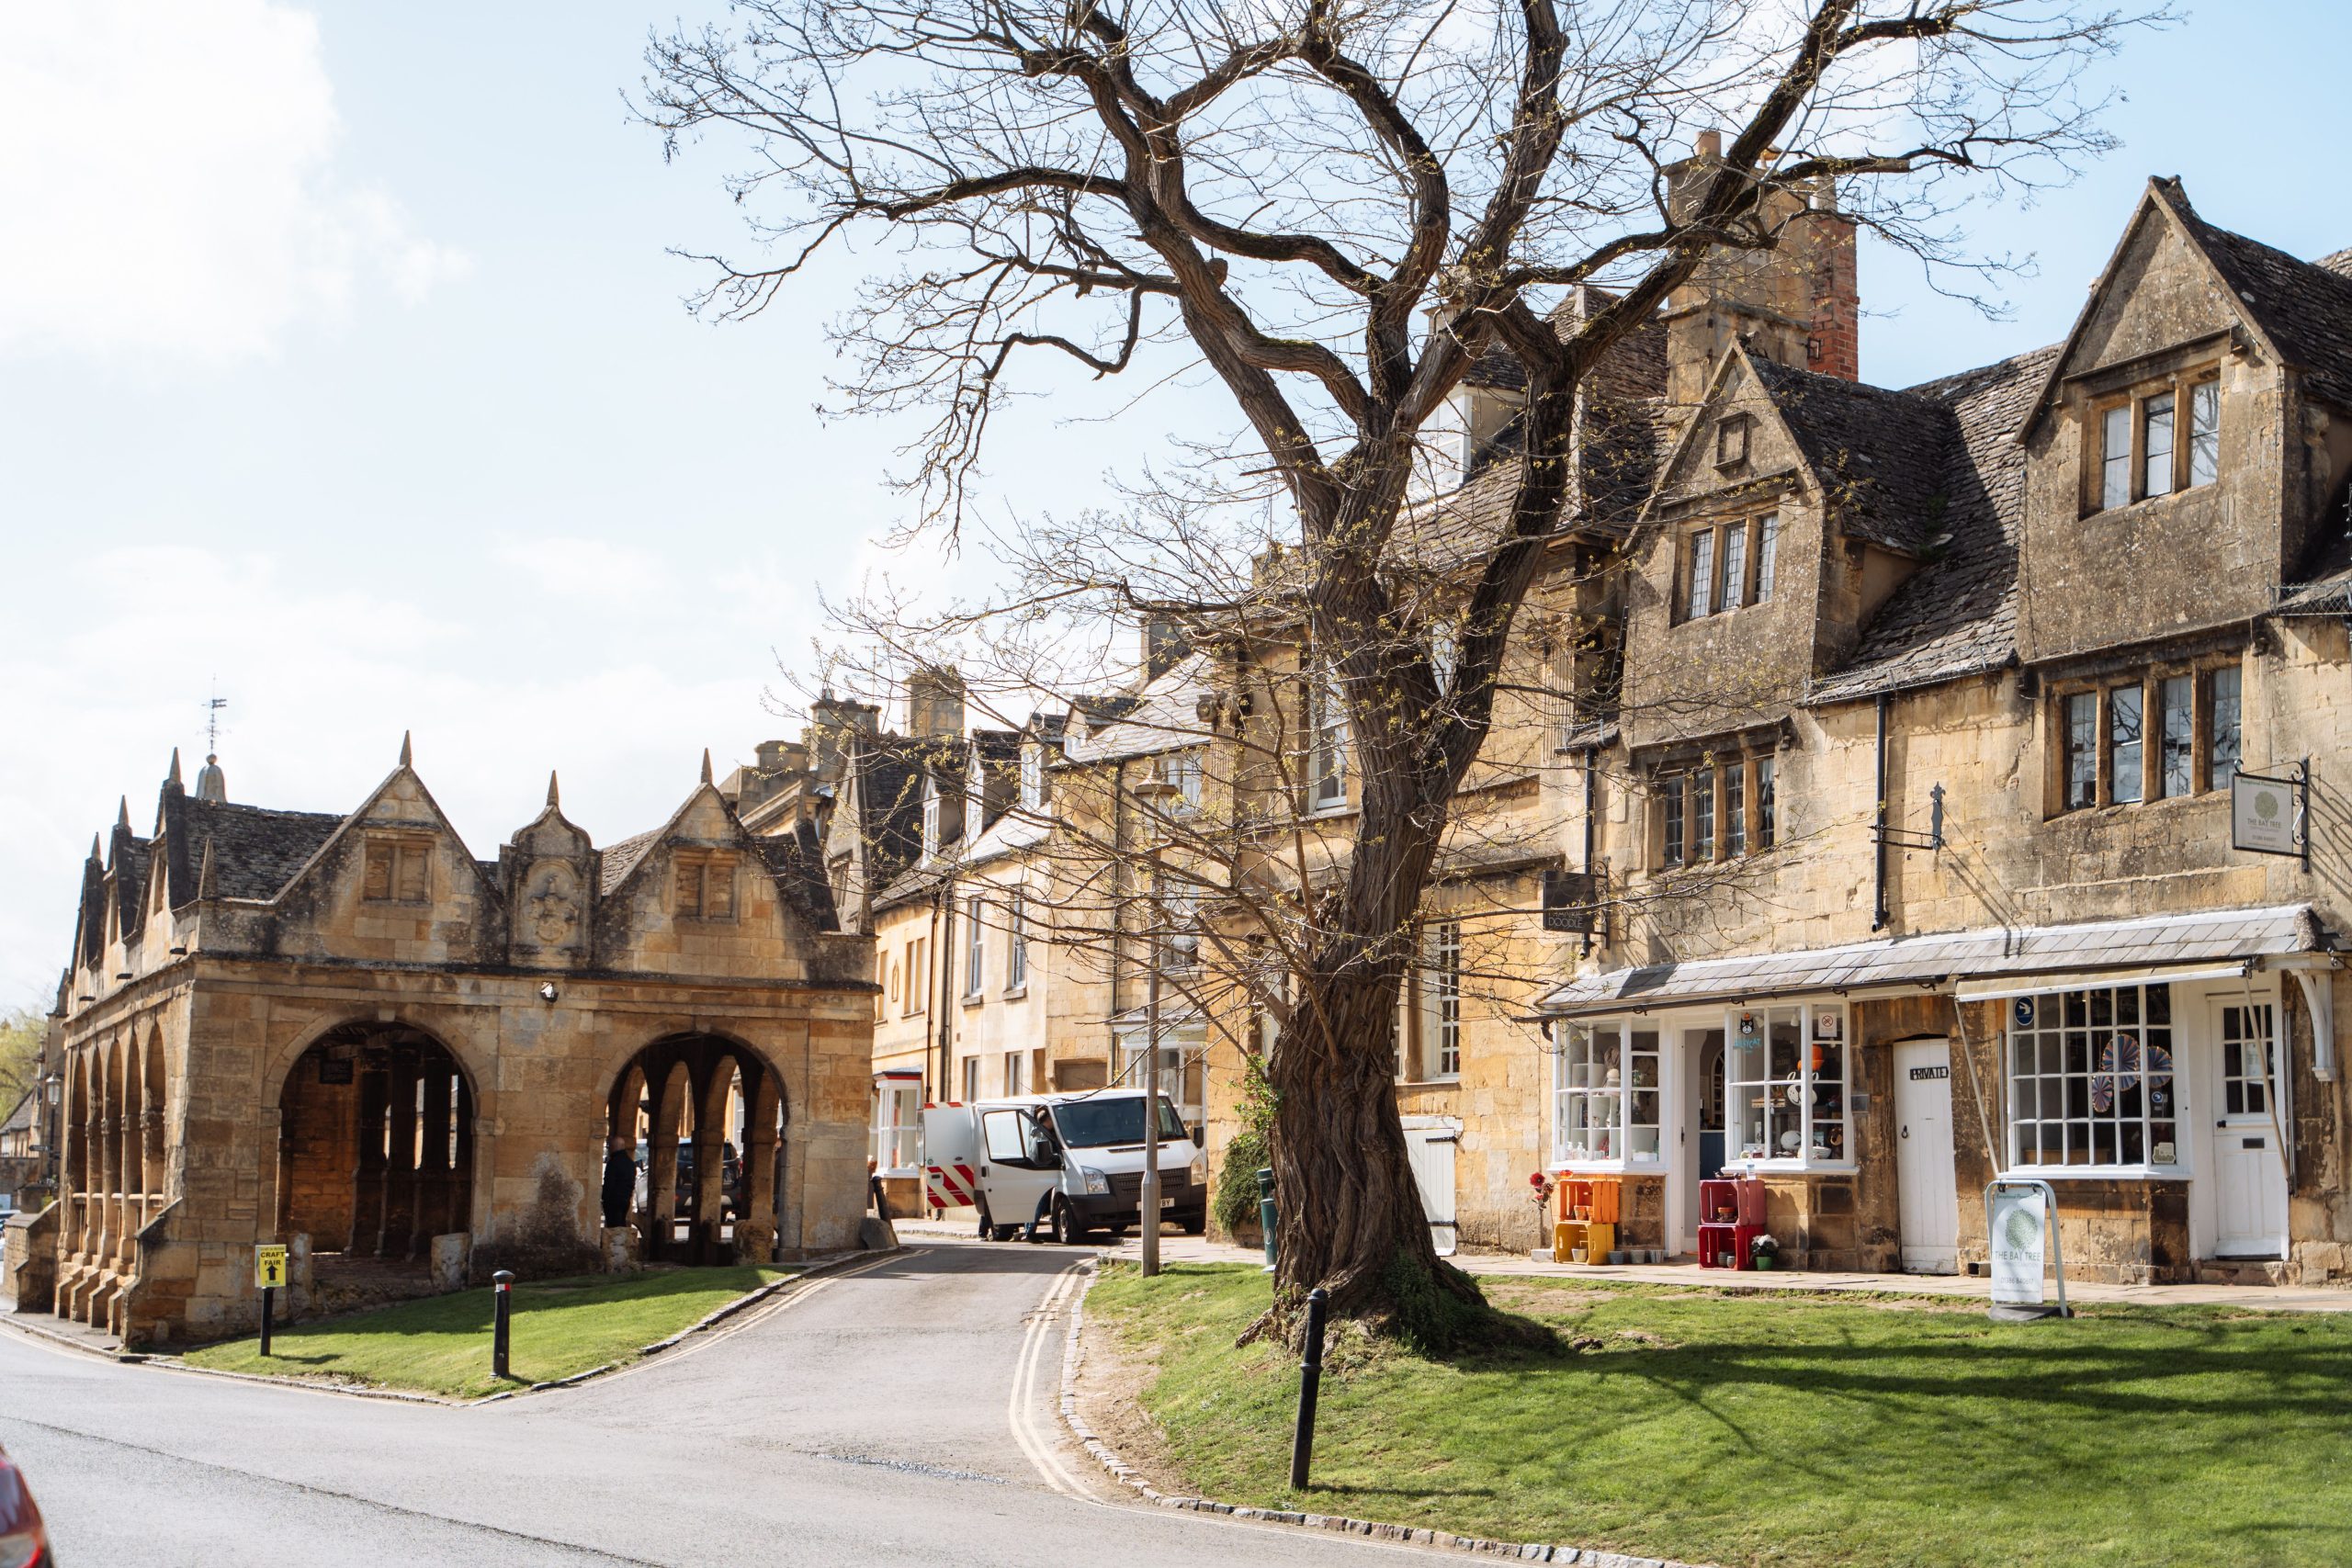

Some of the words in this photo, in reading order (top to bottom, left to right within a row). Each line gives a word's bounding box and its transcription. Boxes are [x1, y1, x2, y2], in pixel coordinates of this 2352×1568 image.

[1548, 917, 1583, 928] DOODLE
[1910, 1066, 1948, 1080] PRIVATE
[1995, 1251, 2007, 1260] THE
[2009, 1249, 2024, 1261] BAY
[2025, 1252, 2041, 1261] TREE
